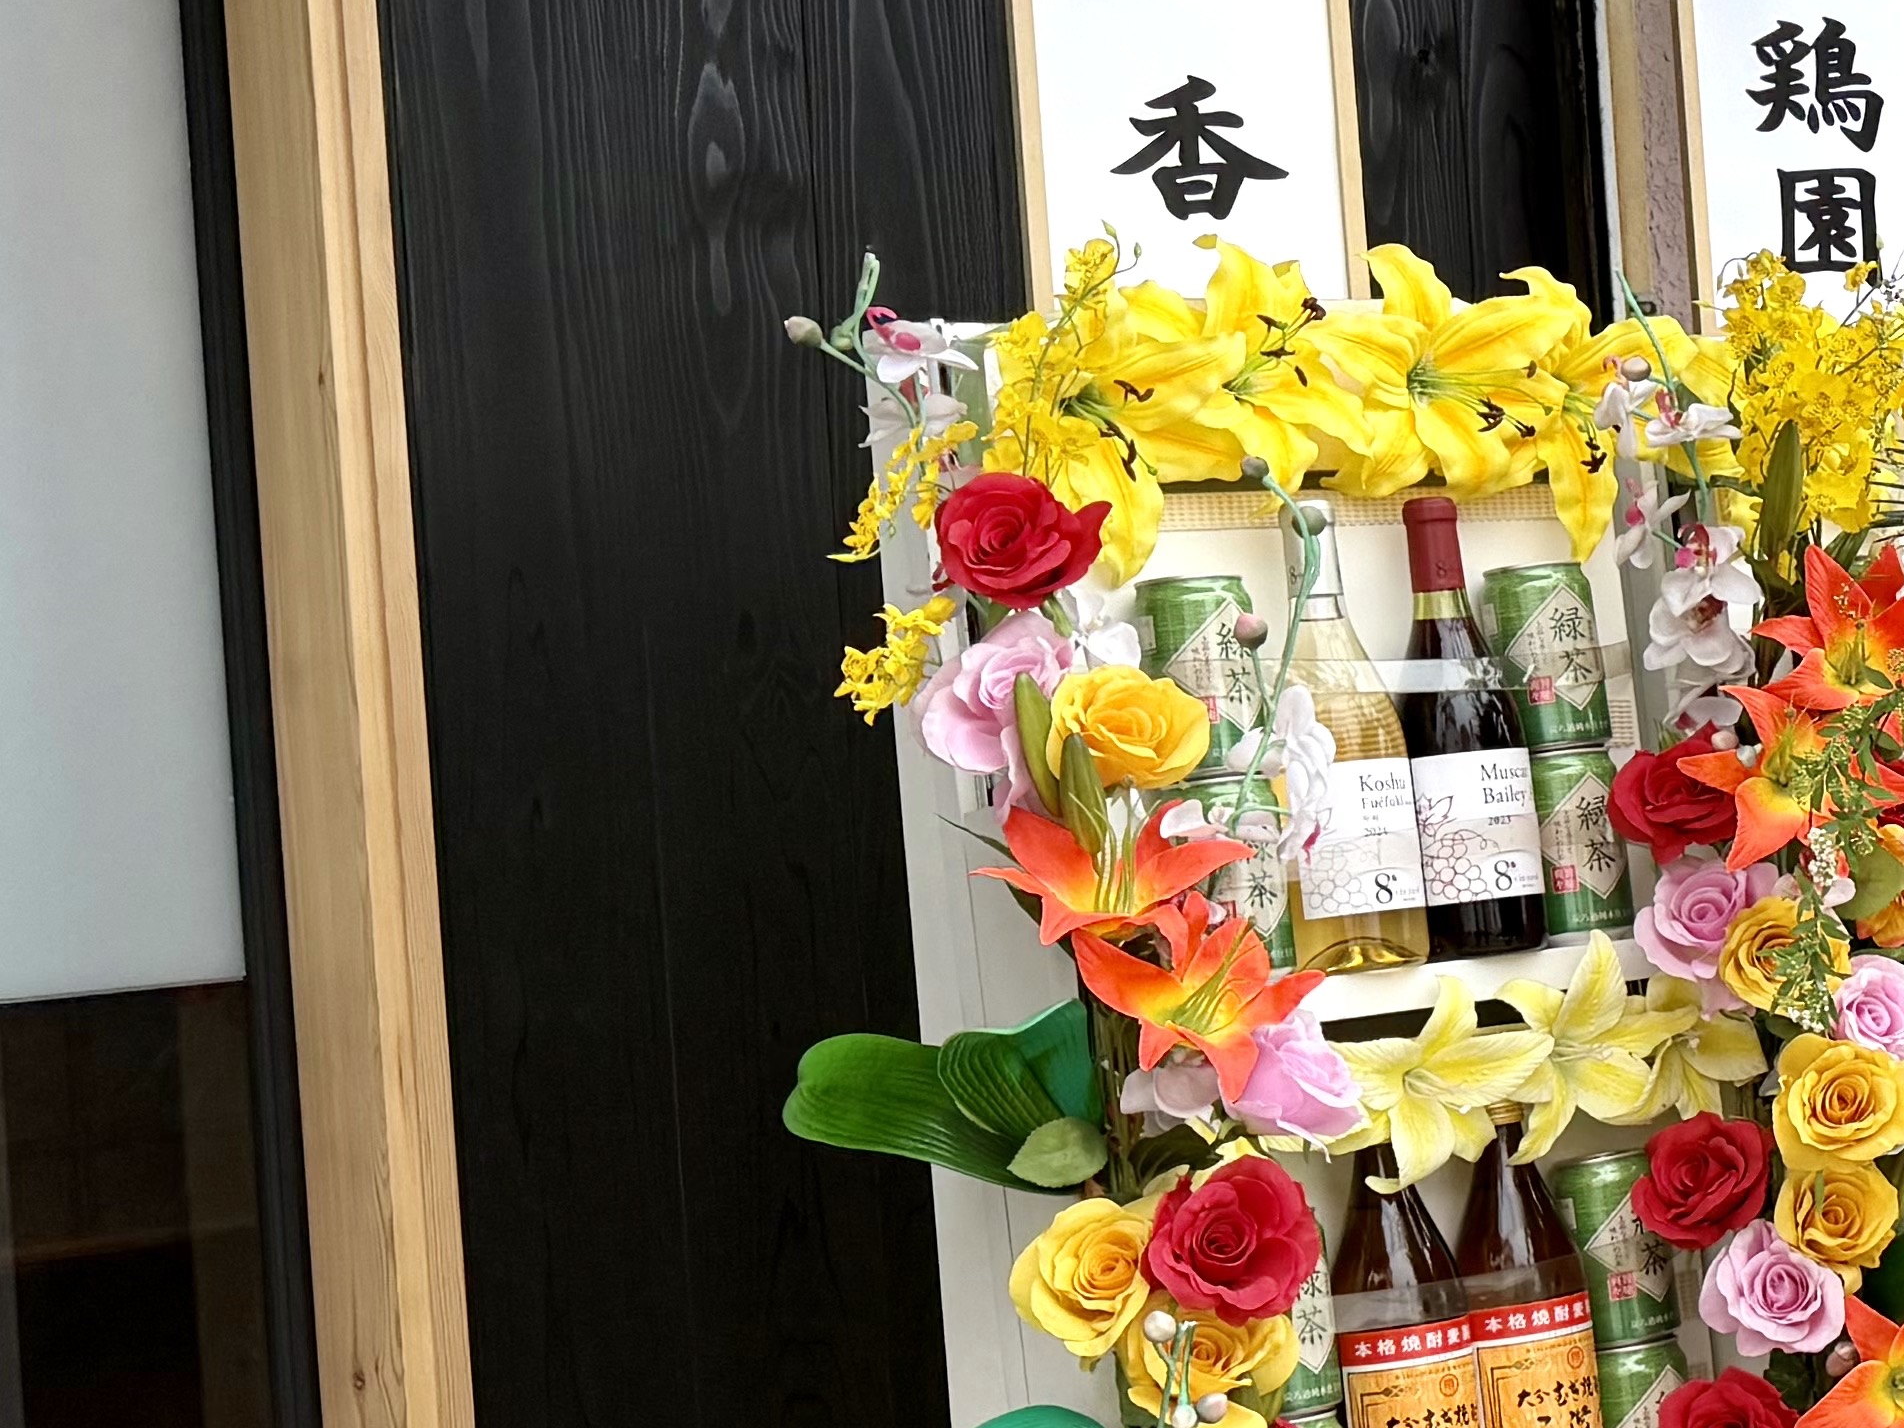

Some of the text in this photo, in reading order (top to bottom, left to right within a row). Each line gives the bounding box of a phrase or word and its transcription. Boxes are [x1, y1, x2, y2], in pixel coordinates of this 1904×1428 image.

[1549, 606, 1593, 683] 緑茶
[1485, 1297, 1591, 1332] 本格焼酎麦
